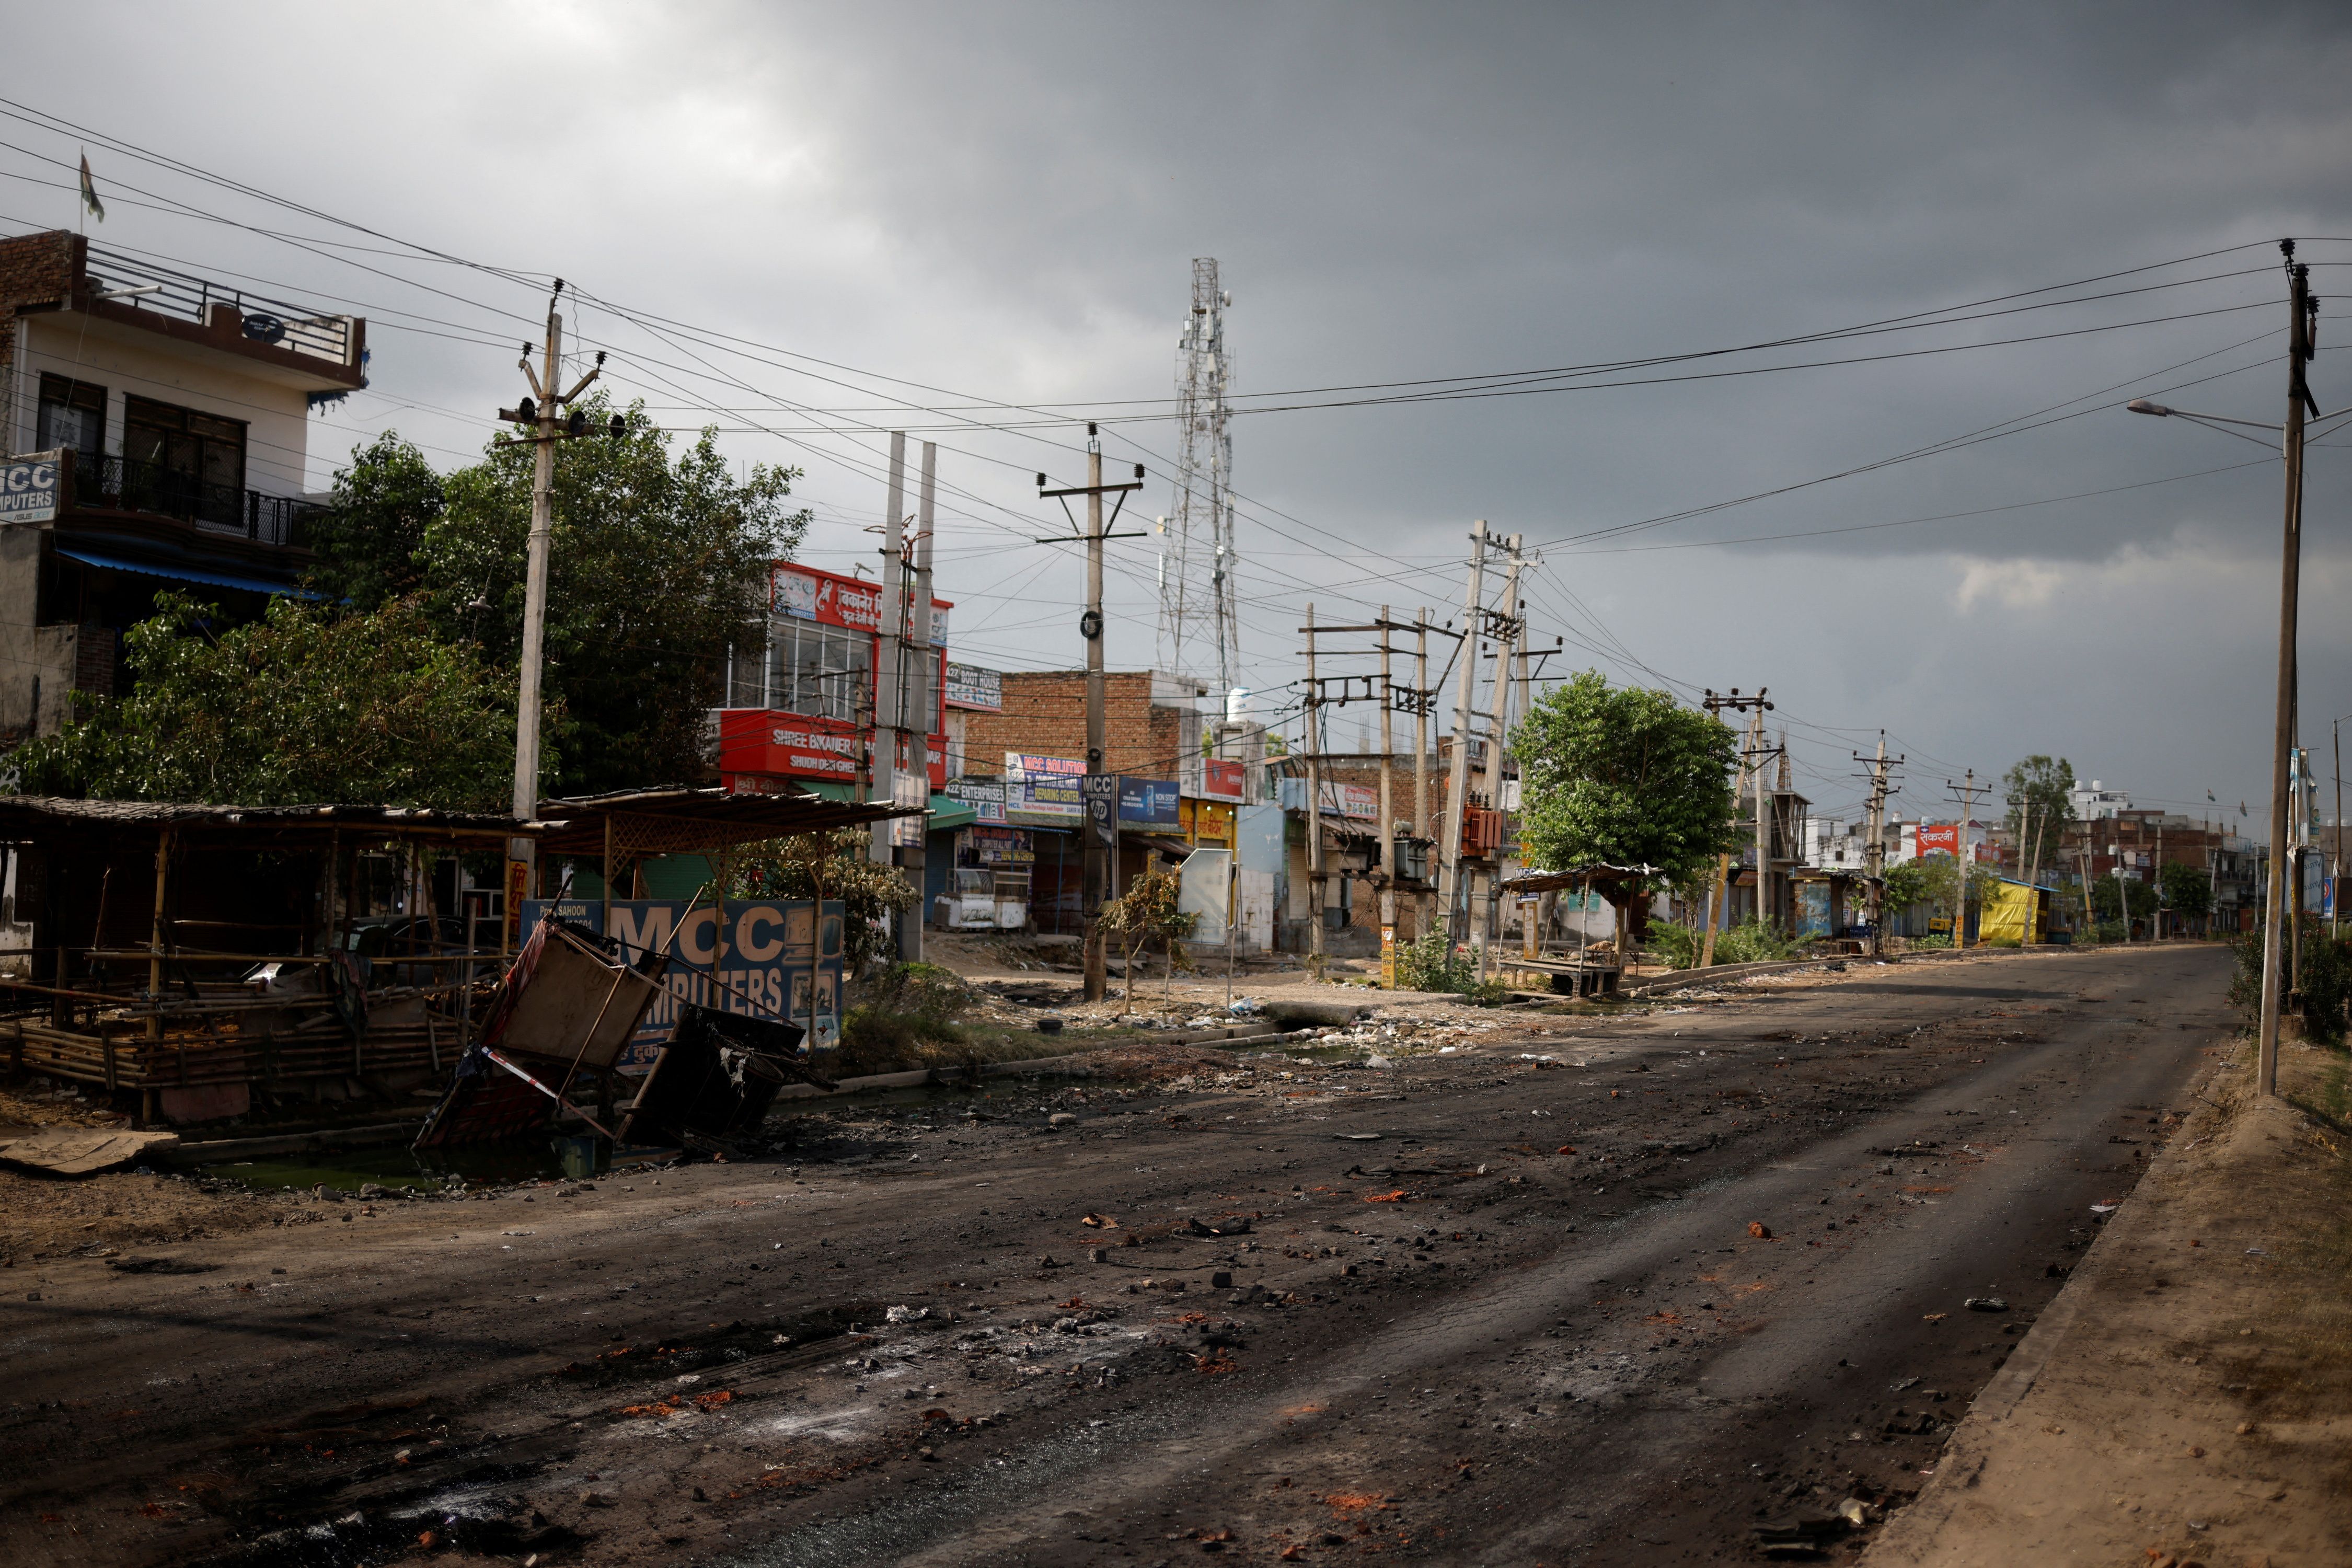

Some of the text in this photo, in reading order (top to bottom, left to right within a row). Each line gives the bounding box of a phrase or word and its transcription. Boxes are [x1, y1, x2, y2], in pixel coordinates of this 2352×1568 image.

[0, 463, 54, 493] CC
[961, 670, 978, 686] BOOT
[979, 673, 1000, 690] HOUSE
[773, 729, 807, 748] SHREE
[790, 755, 817, 768] SHUDH
[818, 758, 836, 770] DESI
[1024, 756, 1044, 773] MCC
[1035, 775, 1056, 788] COMPUTER
[1065, 778, 1077, 789] PARTS
[1083, 777, 1111, 792] MCC
[900, 794, 909, 803] LAND
[961, 785, 1004, 802] ENTERPRISES
[1034, 788, 1059, 801] REPARING
[1060, 790, 1079, 803] CENTER
[982, 839, 998, 848] COMPUTER
[1020, 852, 1035, 861] CENTER
[558, 905, 586, 916] SAHOON
[609, 906, 784, 966] MCC
